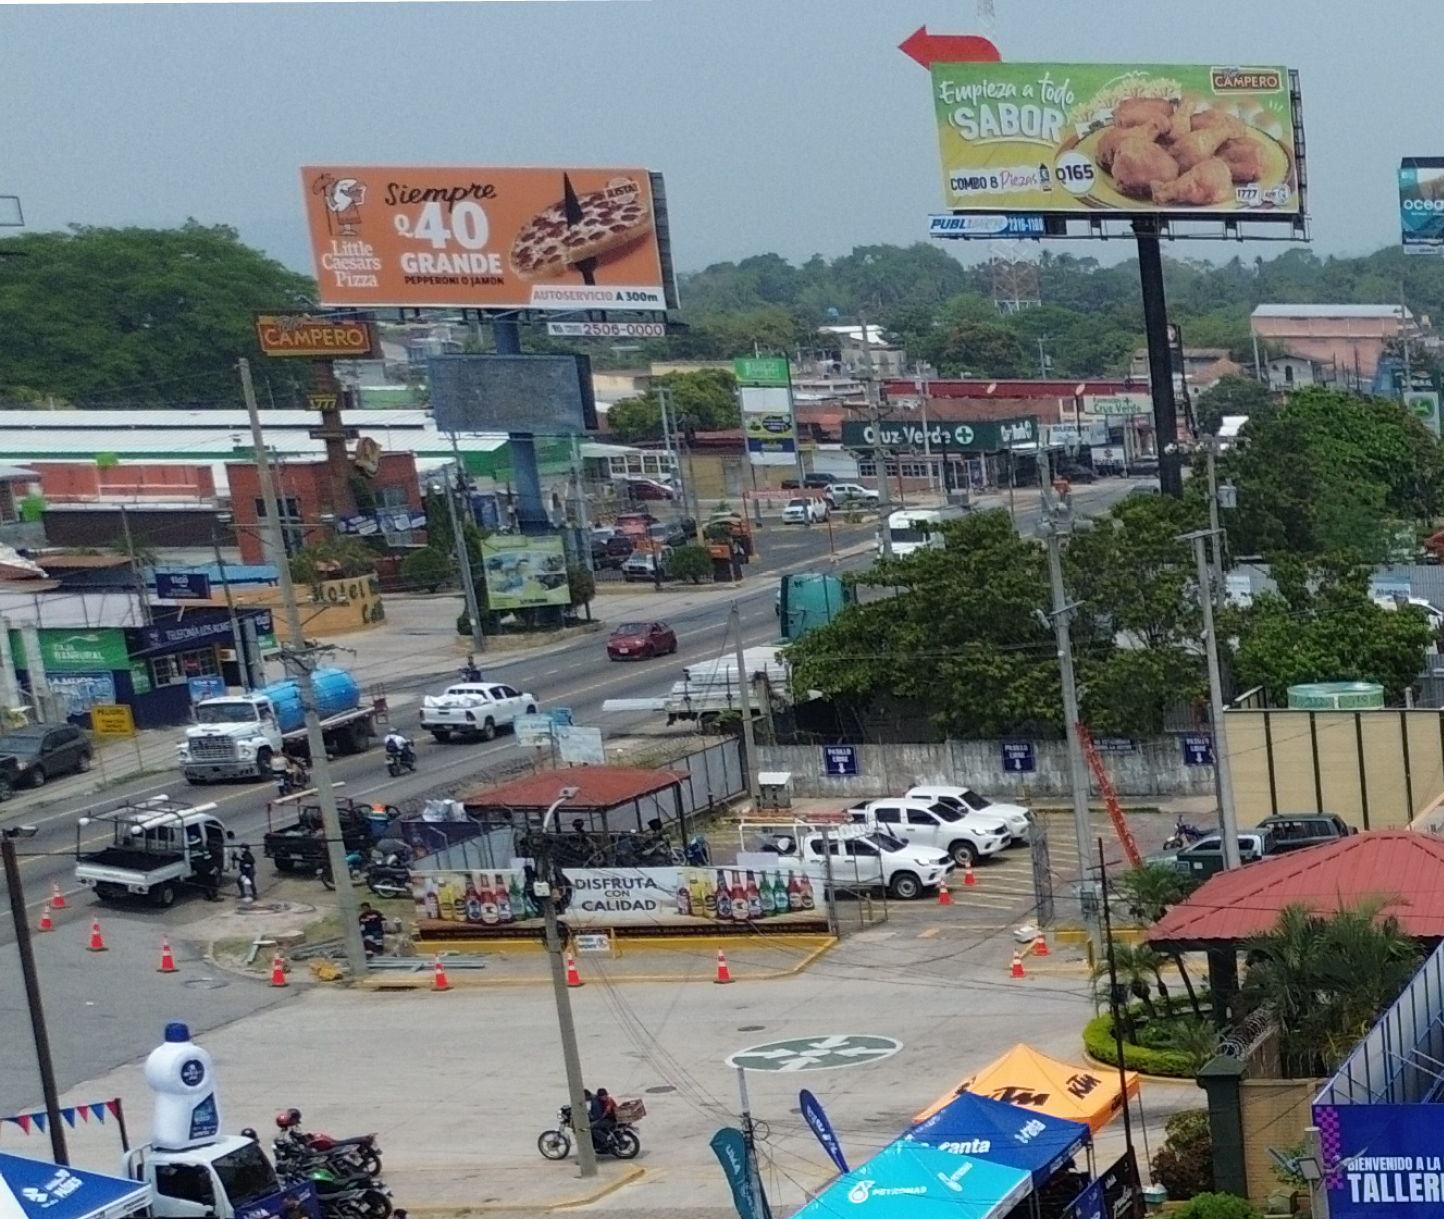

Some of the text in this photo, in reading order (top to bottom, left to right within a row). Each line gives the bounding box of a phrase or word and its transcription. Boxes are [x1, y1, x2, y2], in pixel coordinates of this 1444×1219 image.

[939, 72, 1075, 107] Empieza a todo
[1214, 75, 1279, 91] CAMPERO
[953, 103, 1062, 142] SABOR
[950, 169, 1038, 191] COMBO 8 Piezas
[1055, 163, 1094, 186] Q165
[384, 182, 498, 212] Siempre
[1237, 189, 1258, 201] 1777
[331, 240, 373, 258] Little
[322, 254, 382, 272] Caesars
[401, 252, 503, 275] GRANDE
[335, 271, 379, 288] Pizza
[404, 275, 460, 286] PEPPERONI
[533, 290, 659, 303] AUTOSERVICIO A 300m
[265, 326, 364, 347] CAMPERO
[583, 324, 663, 336] 2506-0000
[574, 877, 657, 891] DISFRUTA
[604, 889, 630, 898] CON
[582, 899, 657, 912] CALIDAD
[1414, 1156, 1424, 1171] A
[1426, 1156, 1441, 1171] LA
[872, 1186, 928, 1197] PETRONAS
